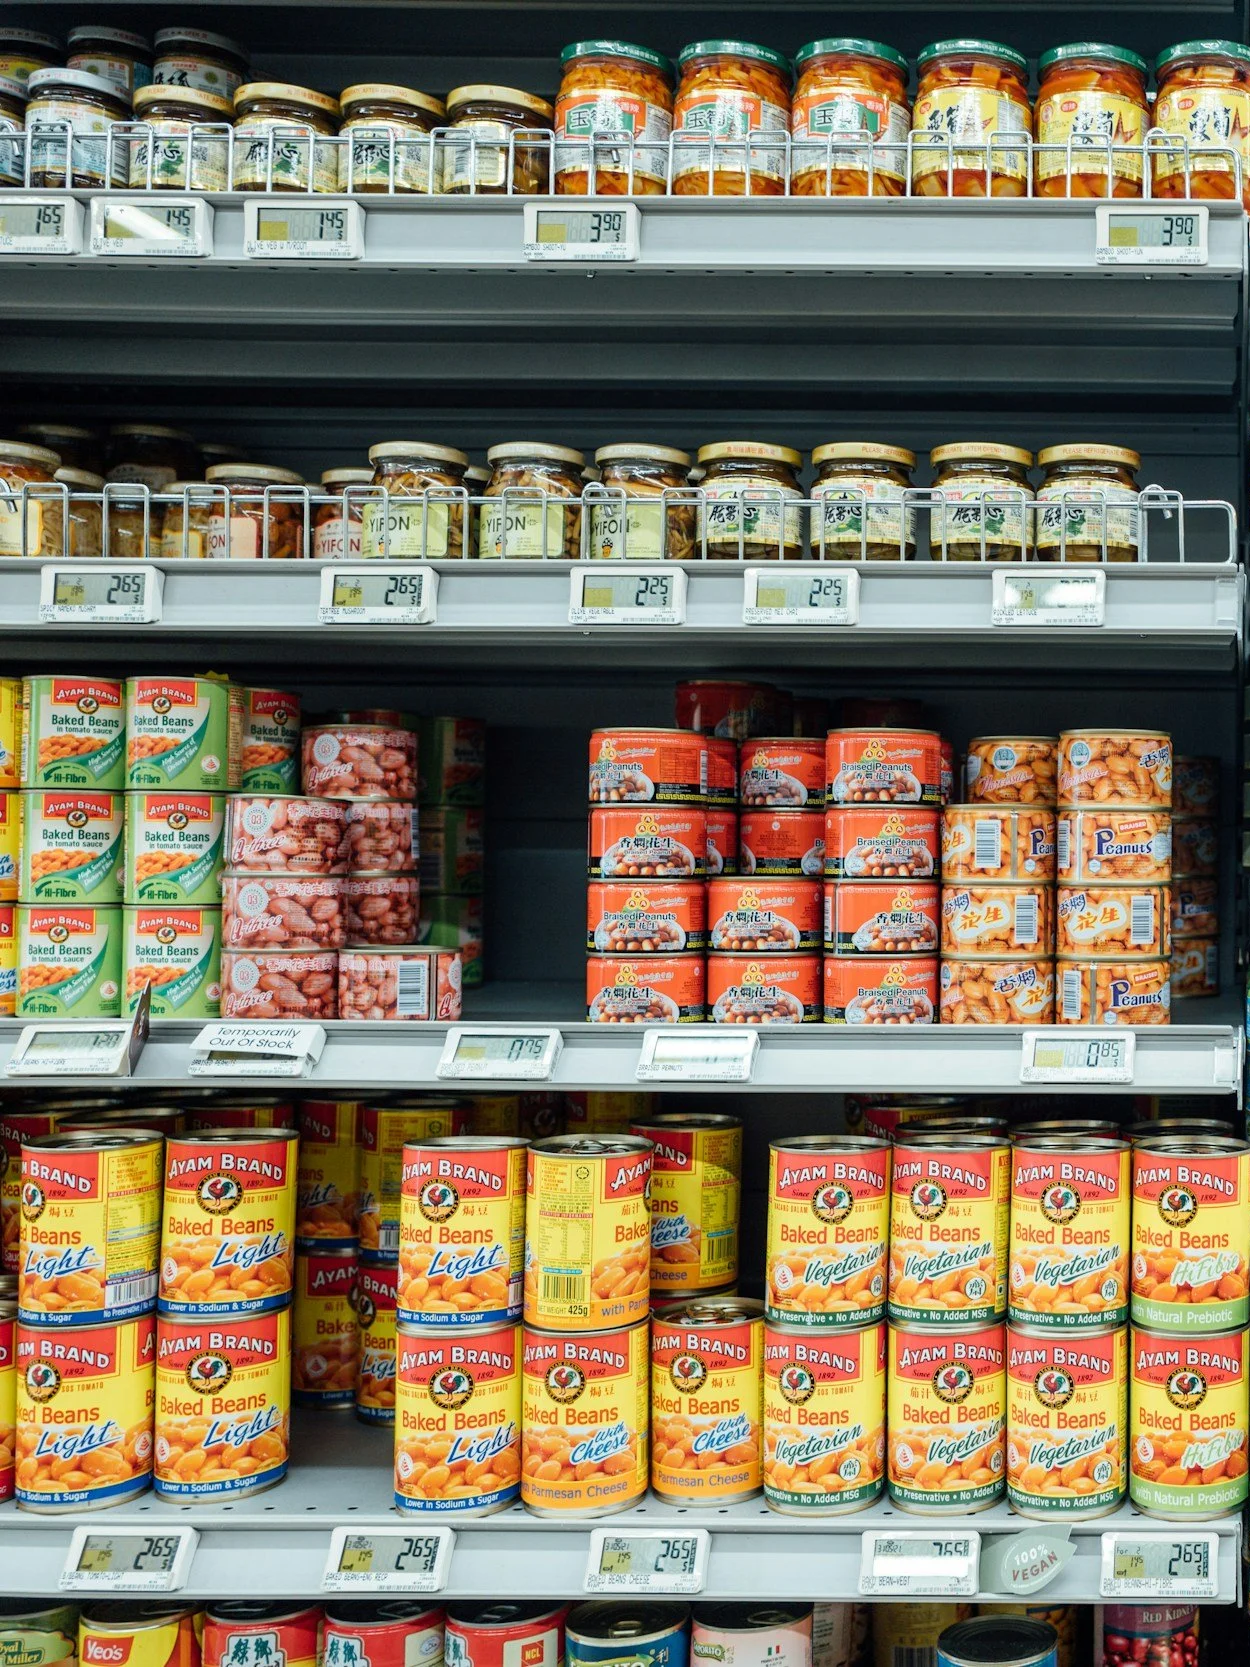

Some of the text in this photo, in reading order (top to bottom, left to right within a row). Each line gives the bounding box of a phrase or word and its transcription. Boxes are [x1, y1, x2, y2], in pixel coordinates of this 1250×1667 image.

[56, 687, 118, 703] AYAM BRAND
[51, 714, 119, 728] Baked Beans
[65, 726, 90, 734] tomato
[841, 762, 912, 773] Braised Peanuts
[1119, 820, 1147, 832] BRAISED
[1095, 829, 1153, 855] Peanuts
[895, 987, 928, 997] Peanuts
[217, 1027, 301, 1040] Temporarily
[209, 1038, 293, 1049] Out Of Stock
[169, 1152, 283, 1181] AYAM BRAND
[169, 1217, 274, 1236] Baked Beans
[1136, 1224, 1229, 1249] Baked Beans
[212, 1233, 288, 1269] Light
[805, 1242, 885, 1285] Vegetarian
[168, 1299, 264, 1312] Lower Sodium Sugar
[568, 1305, 589, 1317] 425g
[780, 1307, 883, 1323] Preservative Added MSG
[1146, 1309, 1232, 1324] Natural Prebiotic
[595, 1422, 625, 1444] With
[570, 1433, 629, 1465] Cheese
[1013, 1543, 1048, 1567] 100%
[1012, 1551, 1057, 1582] VEGAN
[1142, 1610, 1165, 1623] RED
[86, 1636, 124, 1662] Yeo's
[525, 1648, 543, 1662] NCL
